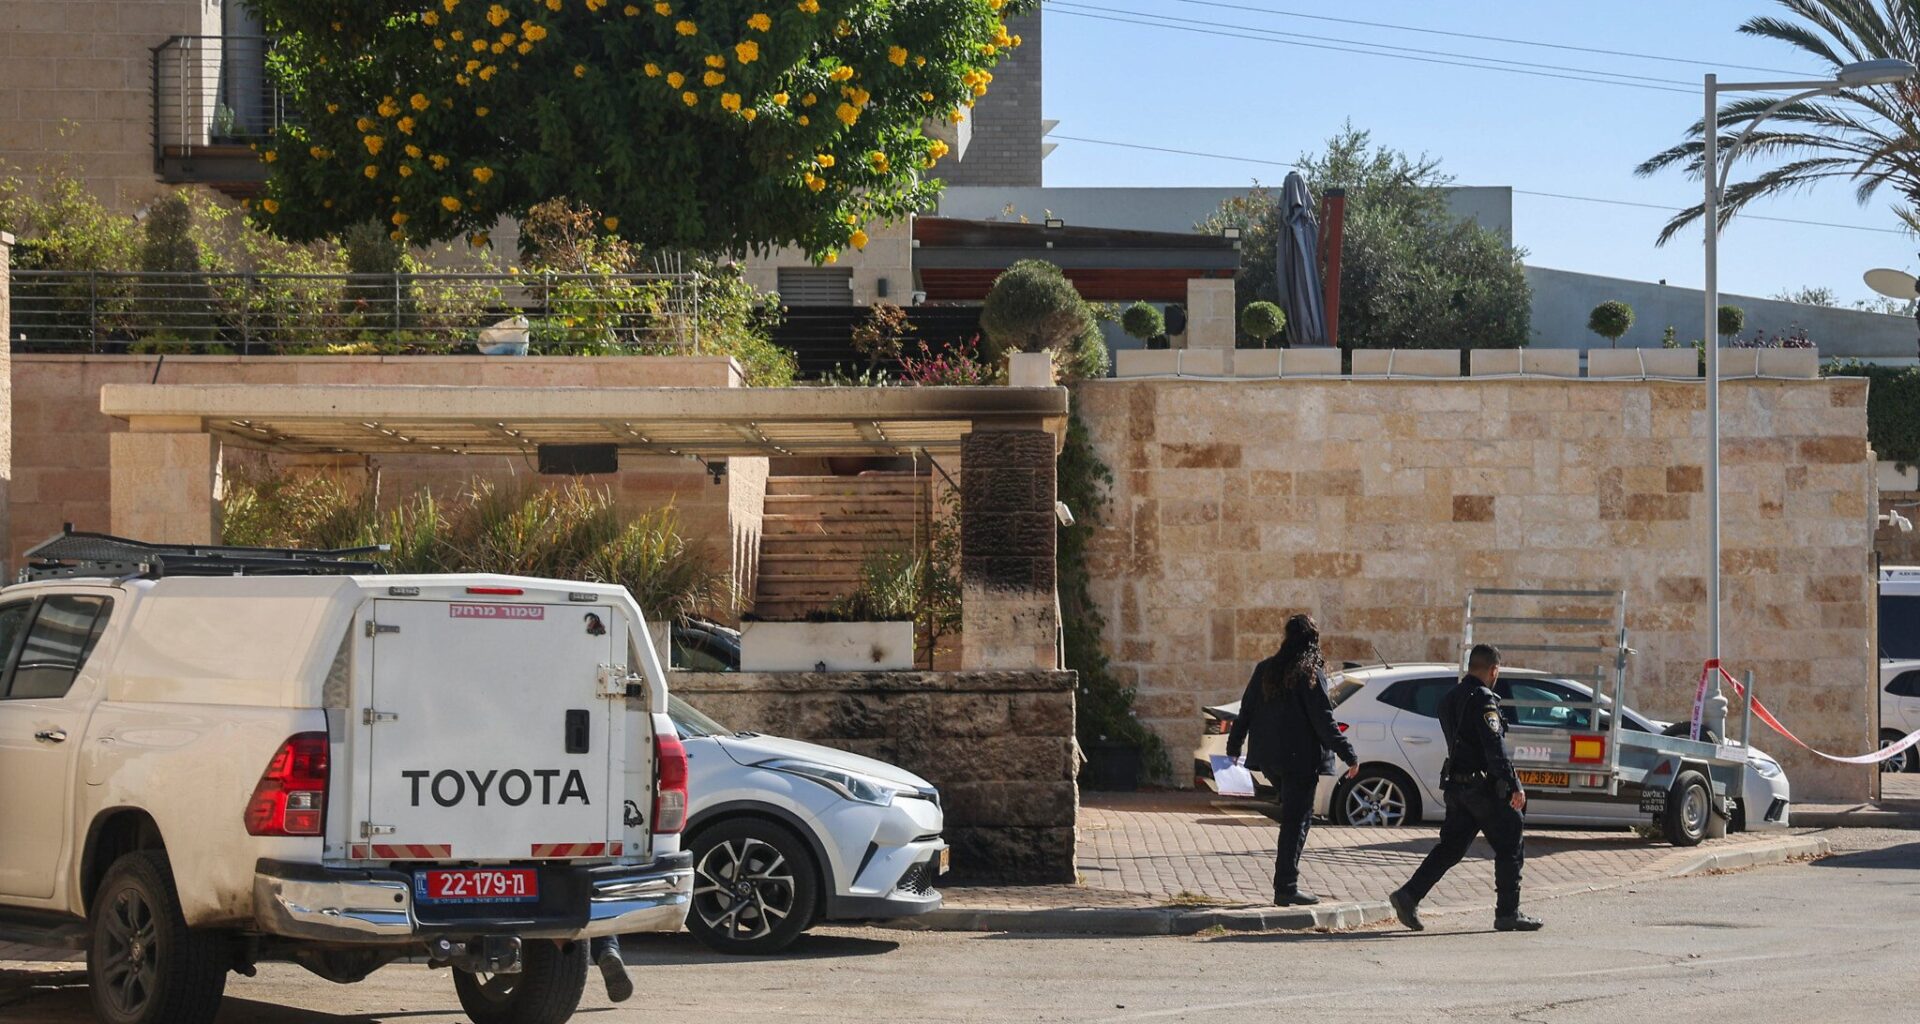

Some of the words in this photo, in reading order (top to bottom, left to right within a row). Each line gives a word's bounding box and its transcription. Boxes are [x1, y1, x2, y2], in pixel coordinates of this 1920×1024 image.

[451, 605, 497, 617] מרחק
[501, 606, 542, 617] שמור
[402, 769, 590, 807] TOYOTA
